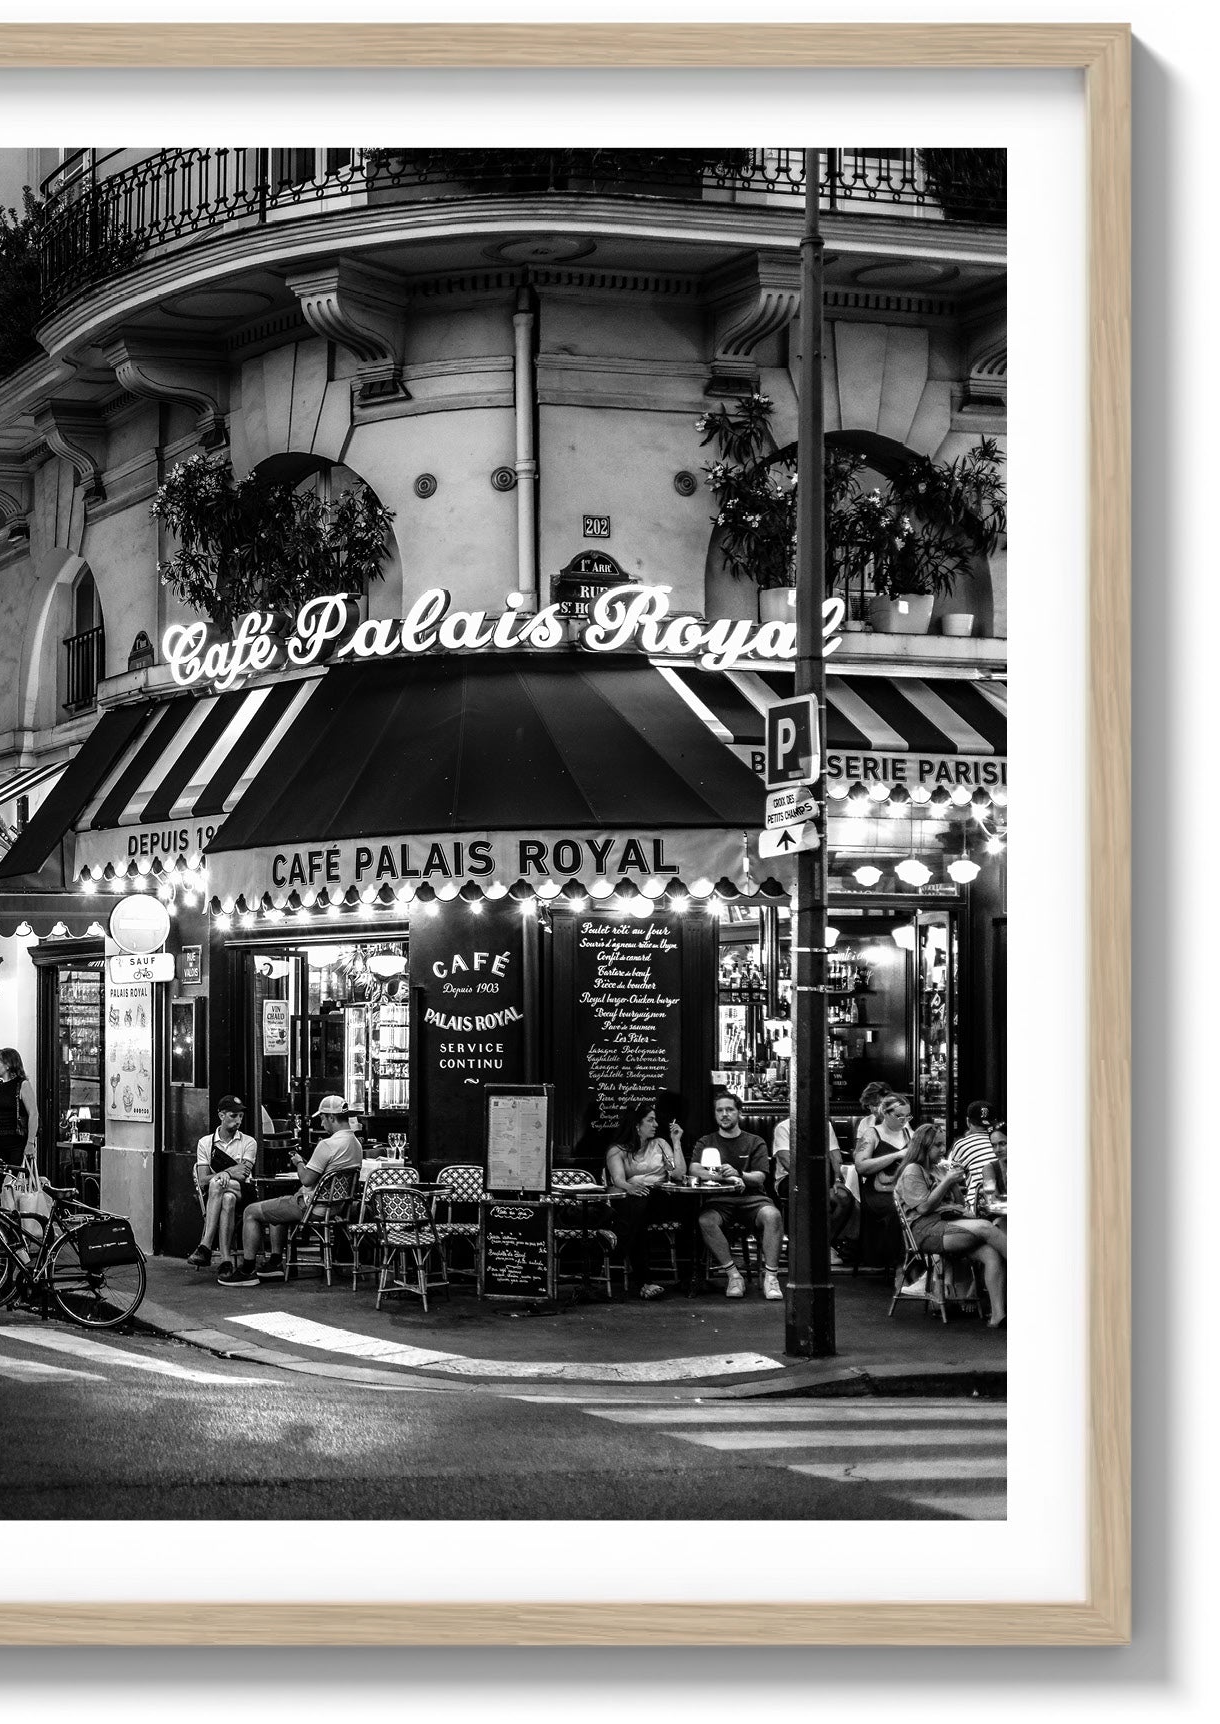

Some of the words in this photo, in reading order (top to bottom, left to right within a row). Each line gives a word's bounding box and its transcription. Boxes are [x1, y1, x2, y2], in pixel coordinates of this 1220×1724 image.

[586, 518, 608, 535] 202
[162, 612, 278, 689] Café
[288, 588, 563, 664] Palais
[777, 717, 796, 770] P
[751, 751, 907, 783] BSERIE
[773, 796, 786, 808] CROIX
[786, 794, 795, 805] DES
[767, 811, 784, 824] PETITS
[784, 802, 813, 820] CHAMPS
[128, 828, 189, 857] DEPUIS
[196, 824, 223, 850] 19
[272, 844, 342, 887] CAFÉ
[355, 840, 495, 882] PALAIS
[518, 838, 680, 876] ROYAL
[580, 922, 610, 934] Poulet
[612, 925, 631, 935] rôti
[645, 923, 671, 940] four
[579, 938, 605, 948] Souris
[605, 938, 637, 951] d'agneau
[130, 957, 156, 966] SAUF
[187, 952, 196, 962] RUE
[597, 951, 621, 966] Confit
[626, 953, 652, 961] canard
[432, 951, 511, 979] CAFÉ
[597, 965, 625, 976] Tartare
[442, 983, 473, 998] Depuis
[476, 983, 500, 993] 1903
[593, 978, 617, 989] Pièce
[617, 981, 625, 989] du
[627, 979, 656, 989] boucher
[110, 989, 129, 998] PALAIS
[130, 987, 148, 997] ROYAL
[579, 991, 606, 1007] Royal
[656, 994, 680, 1007] burger
[424, 1007, 473, 1032] PALAIS
[475, 1006, 524, 1031] ROYAL
[618, 1008, 667, 1021] bourguignon
[601, 1021, 622, 1030] Pavé
[613, 1032, 627, 1042] Les
[440, 1043, 504, 1053] SERVICE
[588, 1043, 617, 1057] Lasagne
[621, 1045, 666, 1058] Bolognaise
[439, 1059, 503, 1069] CONTINU
[625, 1054, 669, 1062] Carbonara
[590, 1062, 618, 1073] Lasagne
[596, 1082, 616, 1091] Plats
